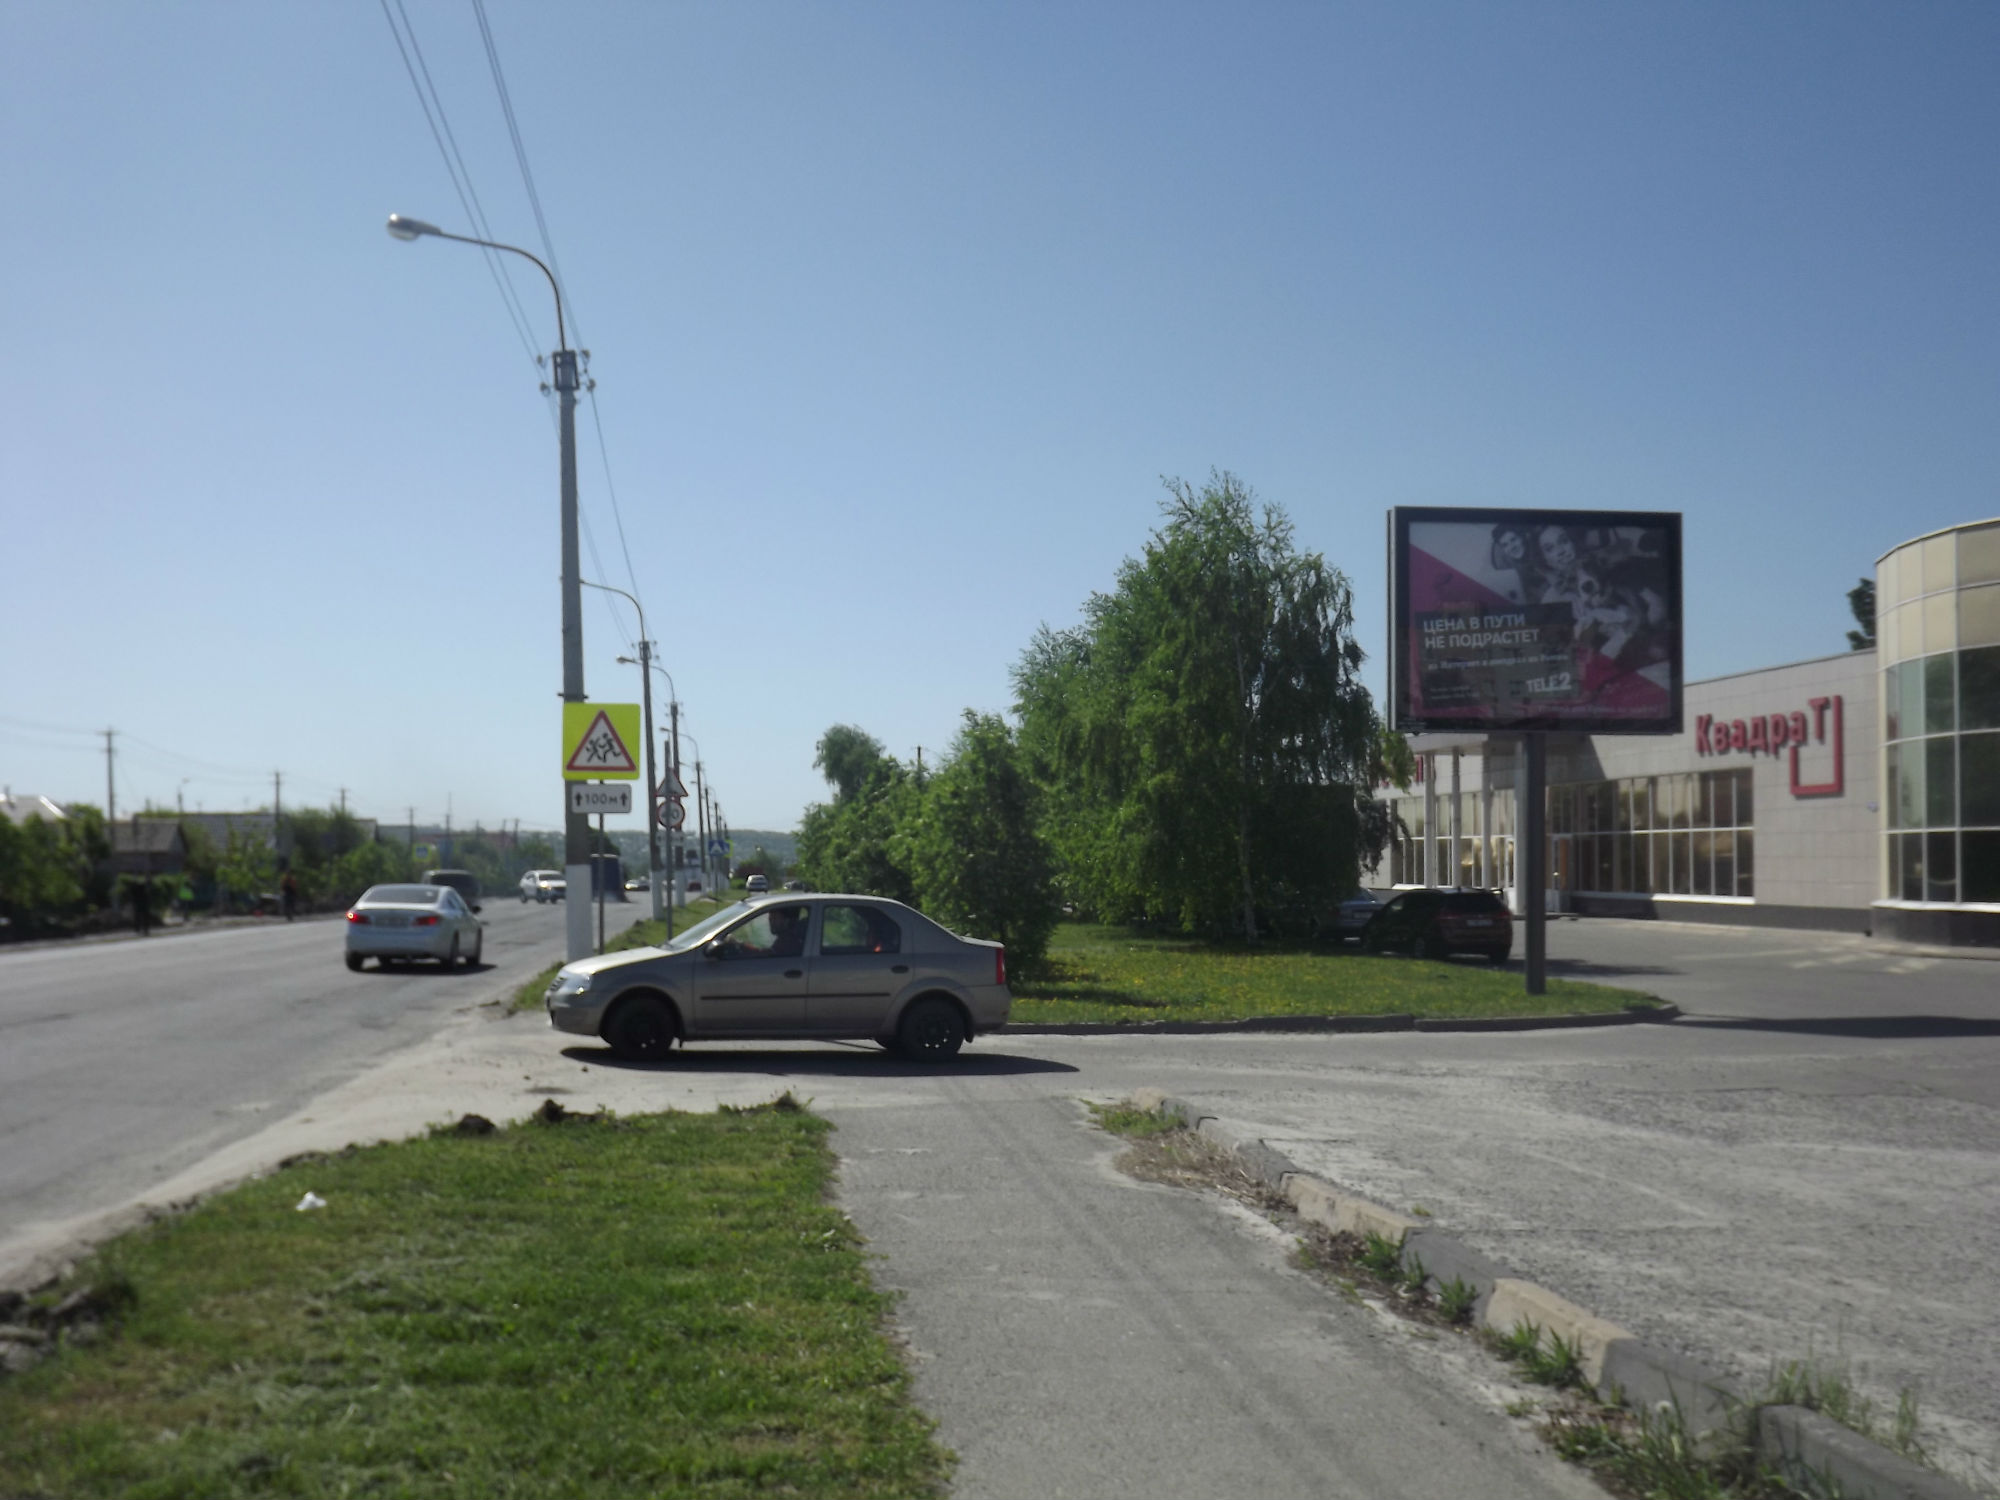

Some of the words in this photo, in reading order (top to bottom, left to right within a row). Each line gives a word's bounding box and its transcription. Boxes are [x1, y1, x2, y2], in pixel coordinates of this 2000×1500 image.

[1423, 617, 1465, 635] ЦЕНА
[1469, 616, 1480, 630] В
[1484, 614, 1526, 629] ПУТИ
[1425, 635, 1446, 649] НЕ
[1449, 629, 1540, 649] ПОДРАСТЕТ
[1525, 672, 1572, 693] TELE2
[585, 792, 619, 806] 100м
